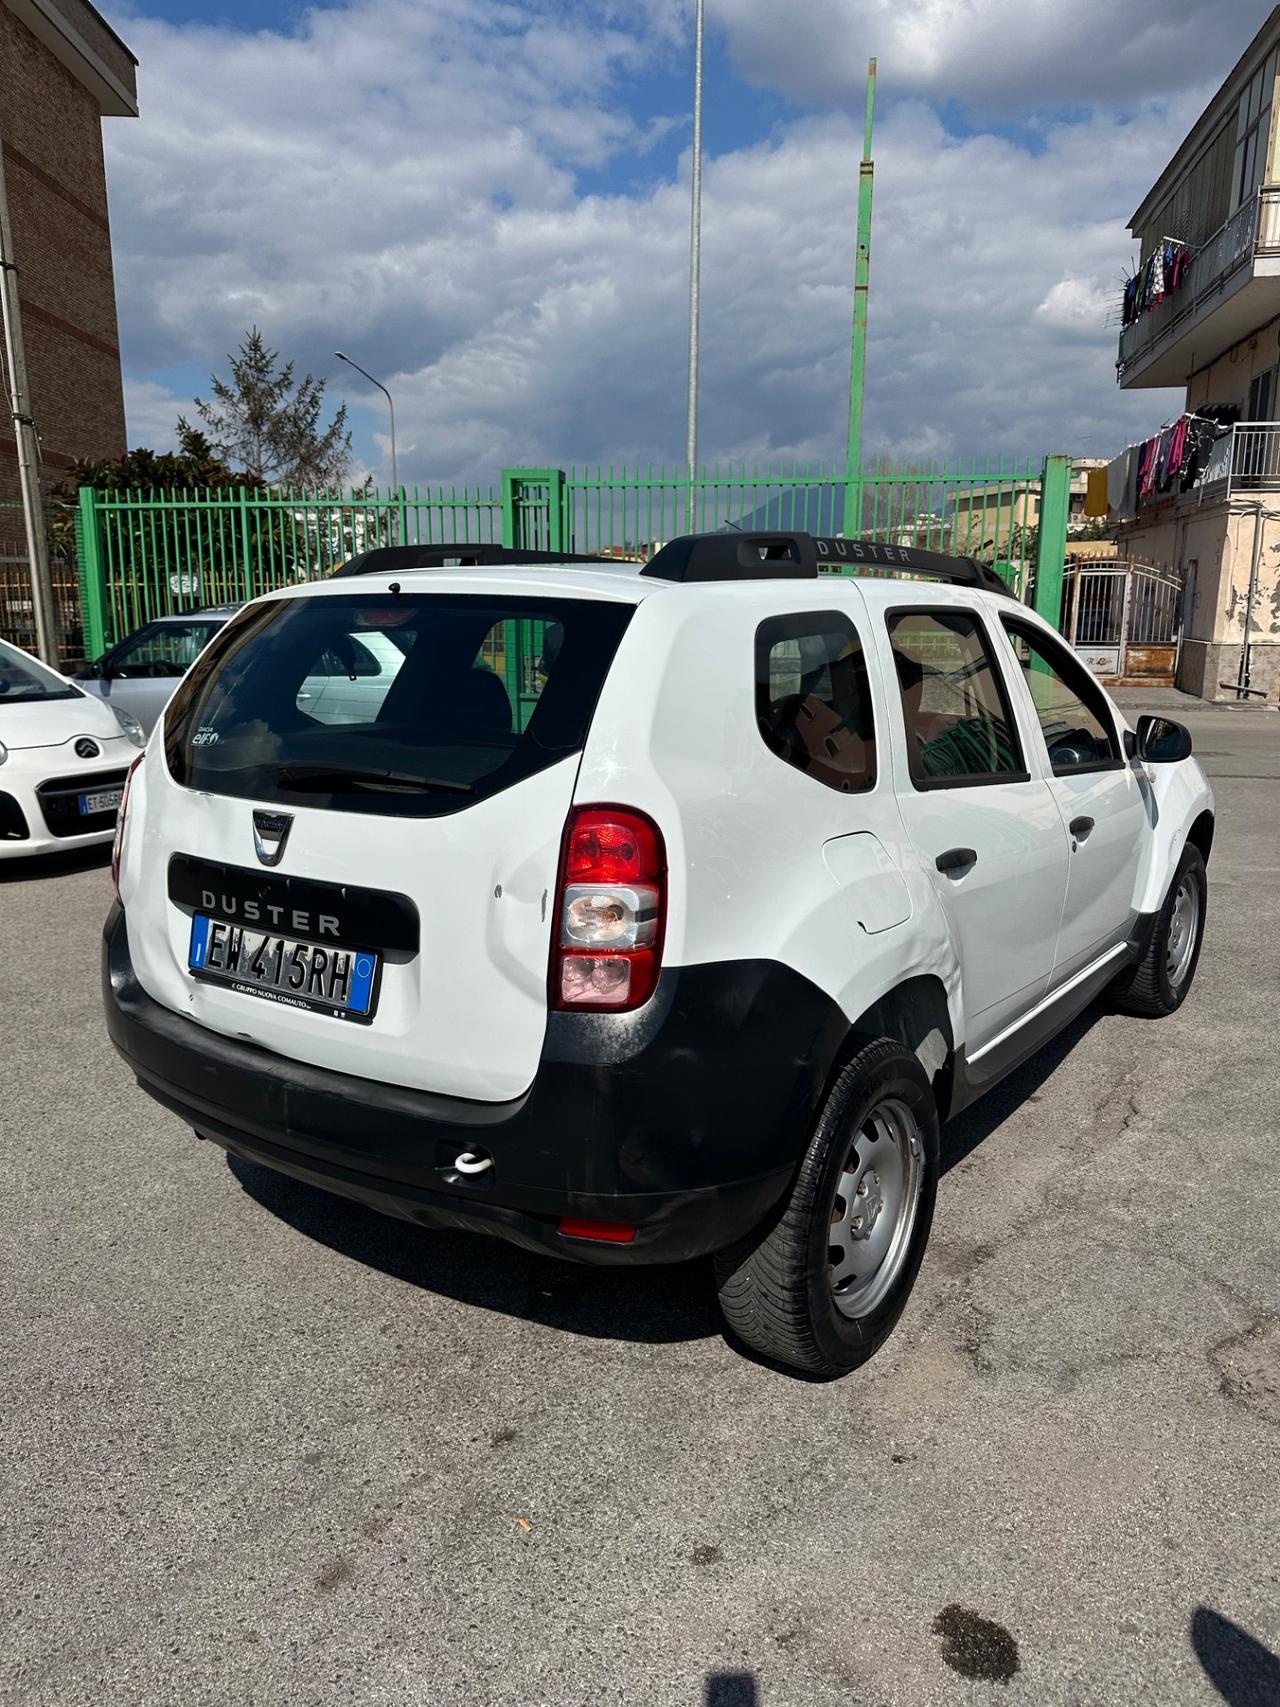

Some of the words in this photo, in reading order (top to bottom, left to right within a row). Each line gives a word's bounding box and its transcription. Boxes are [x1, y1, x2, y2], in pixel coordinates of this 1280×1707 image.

[816, 541, 911, 562] DUSTER
[202, 889, 340, 937] DUSTER
[236, 984, 257, 995] GRUPPO
[258, 990, 277, 1000] NUOVA
